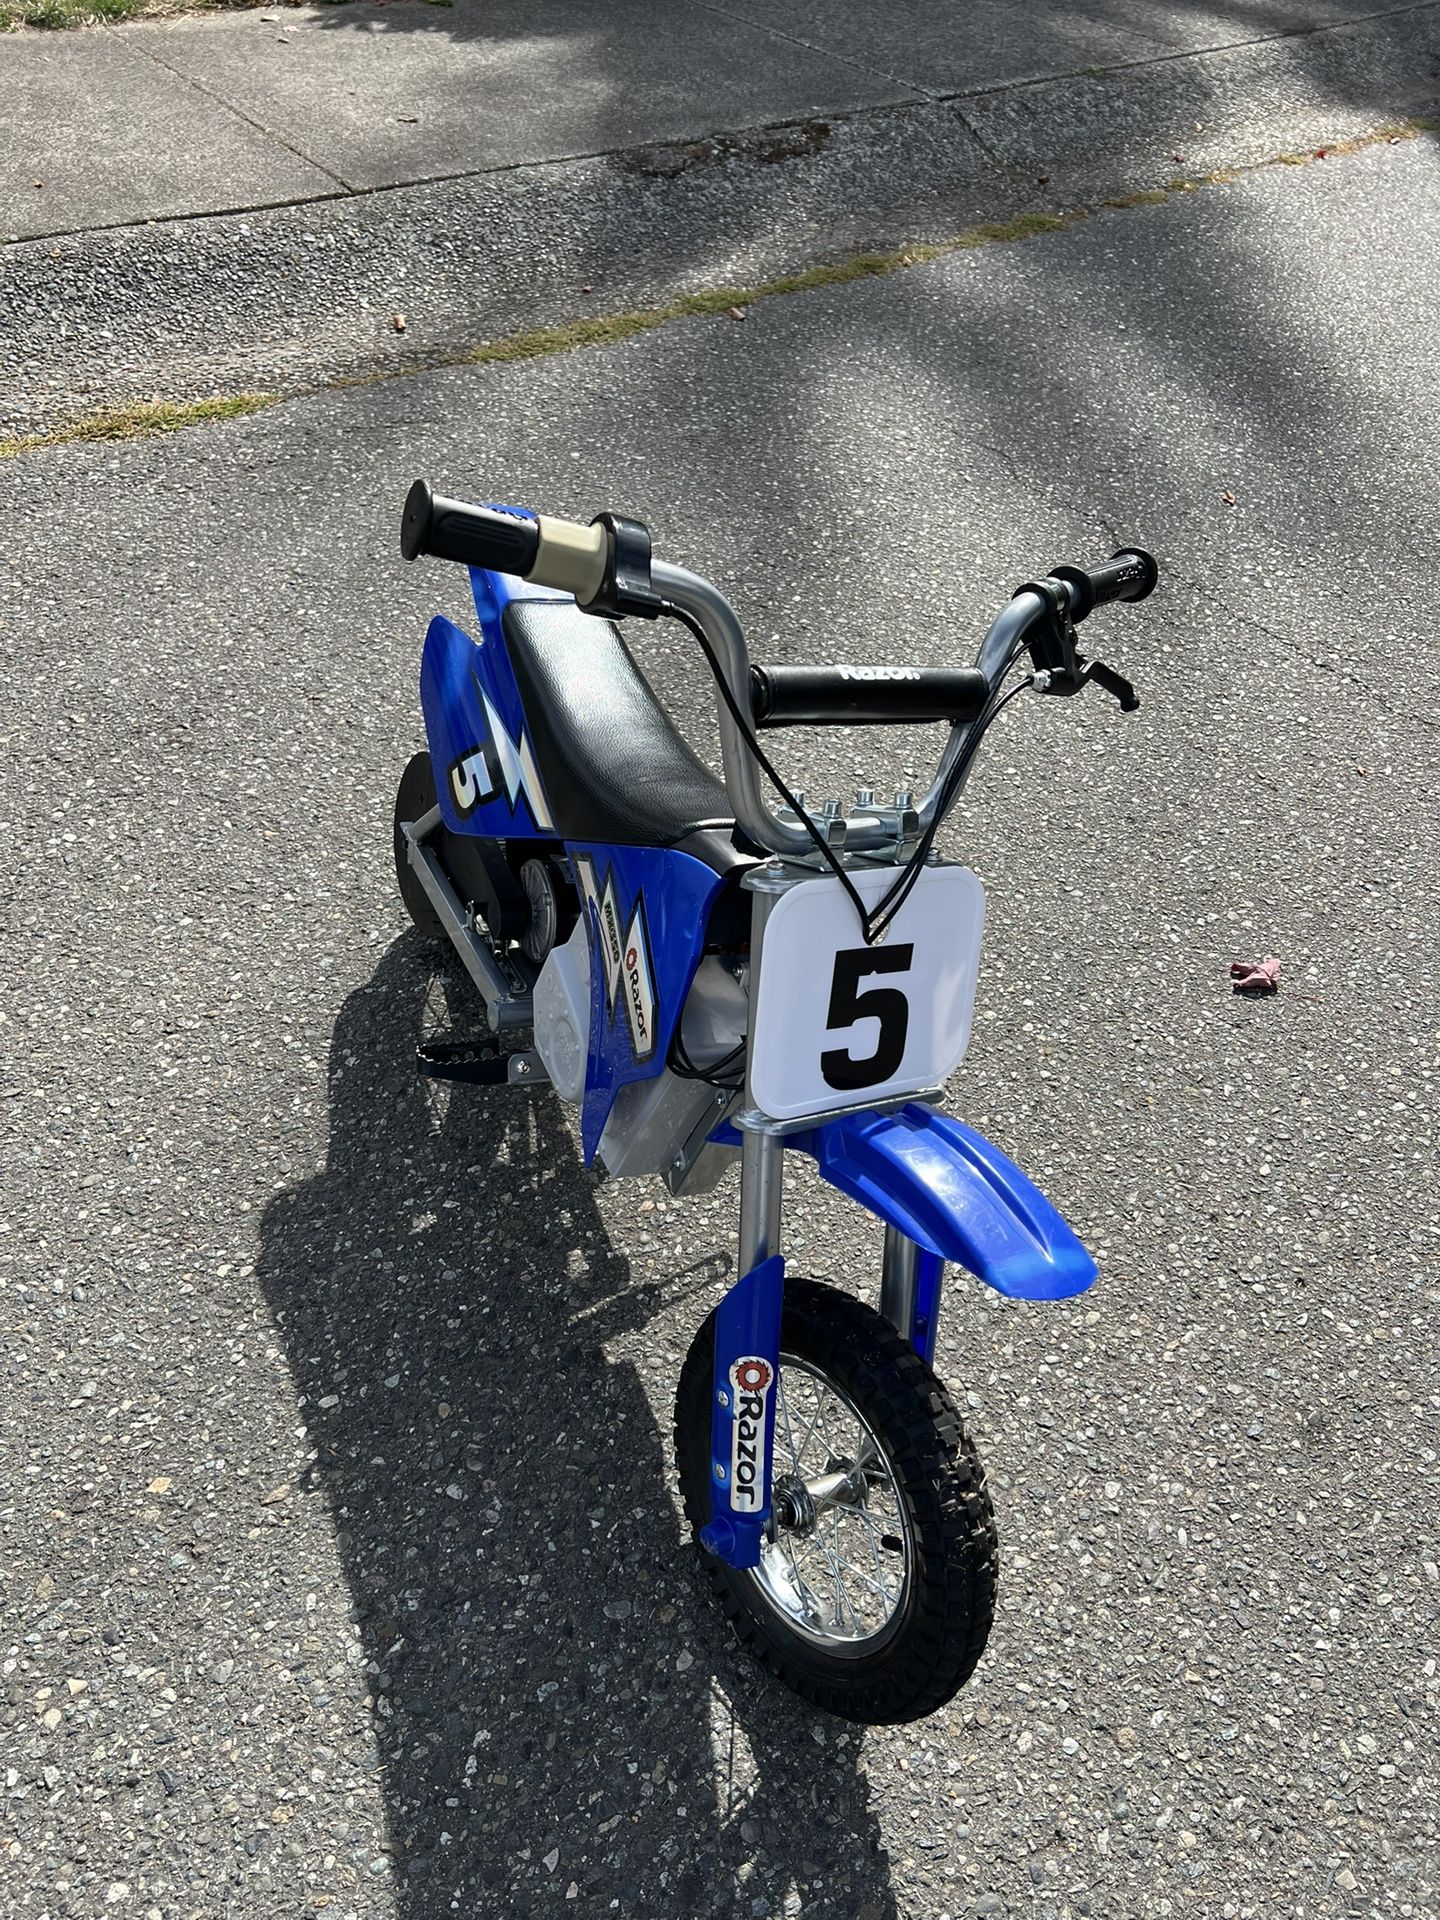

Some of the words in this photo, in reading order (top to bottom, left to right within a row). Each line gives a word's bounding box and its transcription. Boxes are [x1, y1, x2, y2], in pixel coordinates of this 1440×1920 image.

[451, 751, 494, 810] 5
[629, 968, 648, 1041] Razor
[821, 943, 914, 1091] 5
[736, 1393, 764, 1506] Razor
